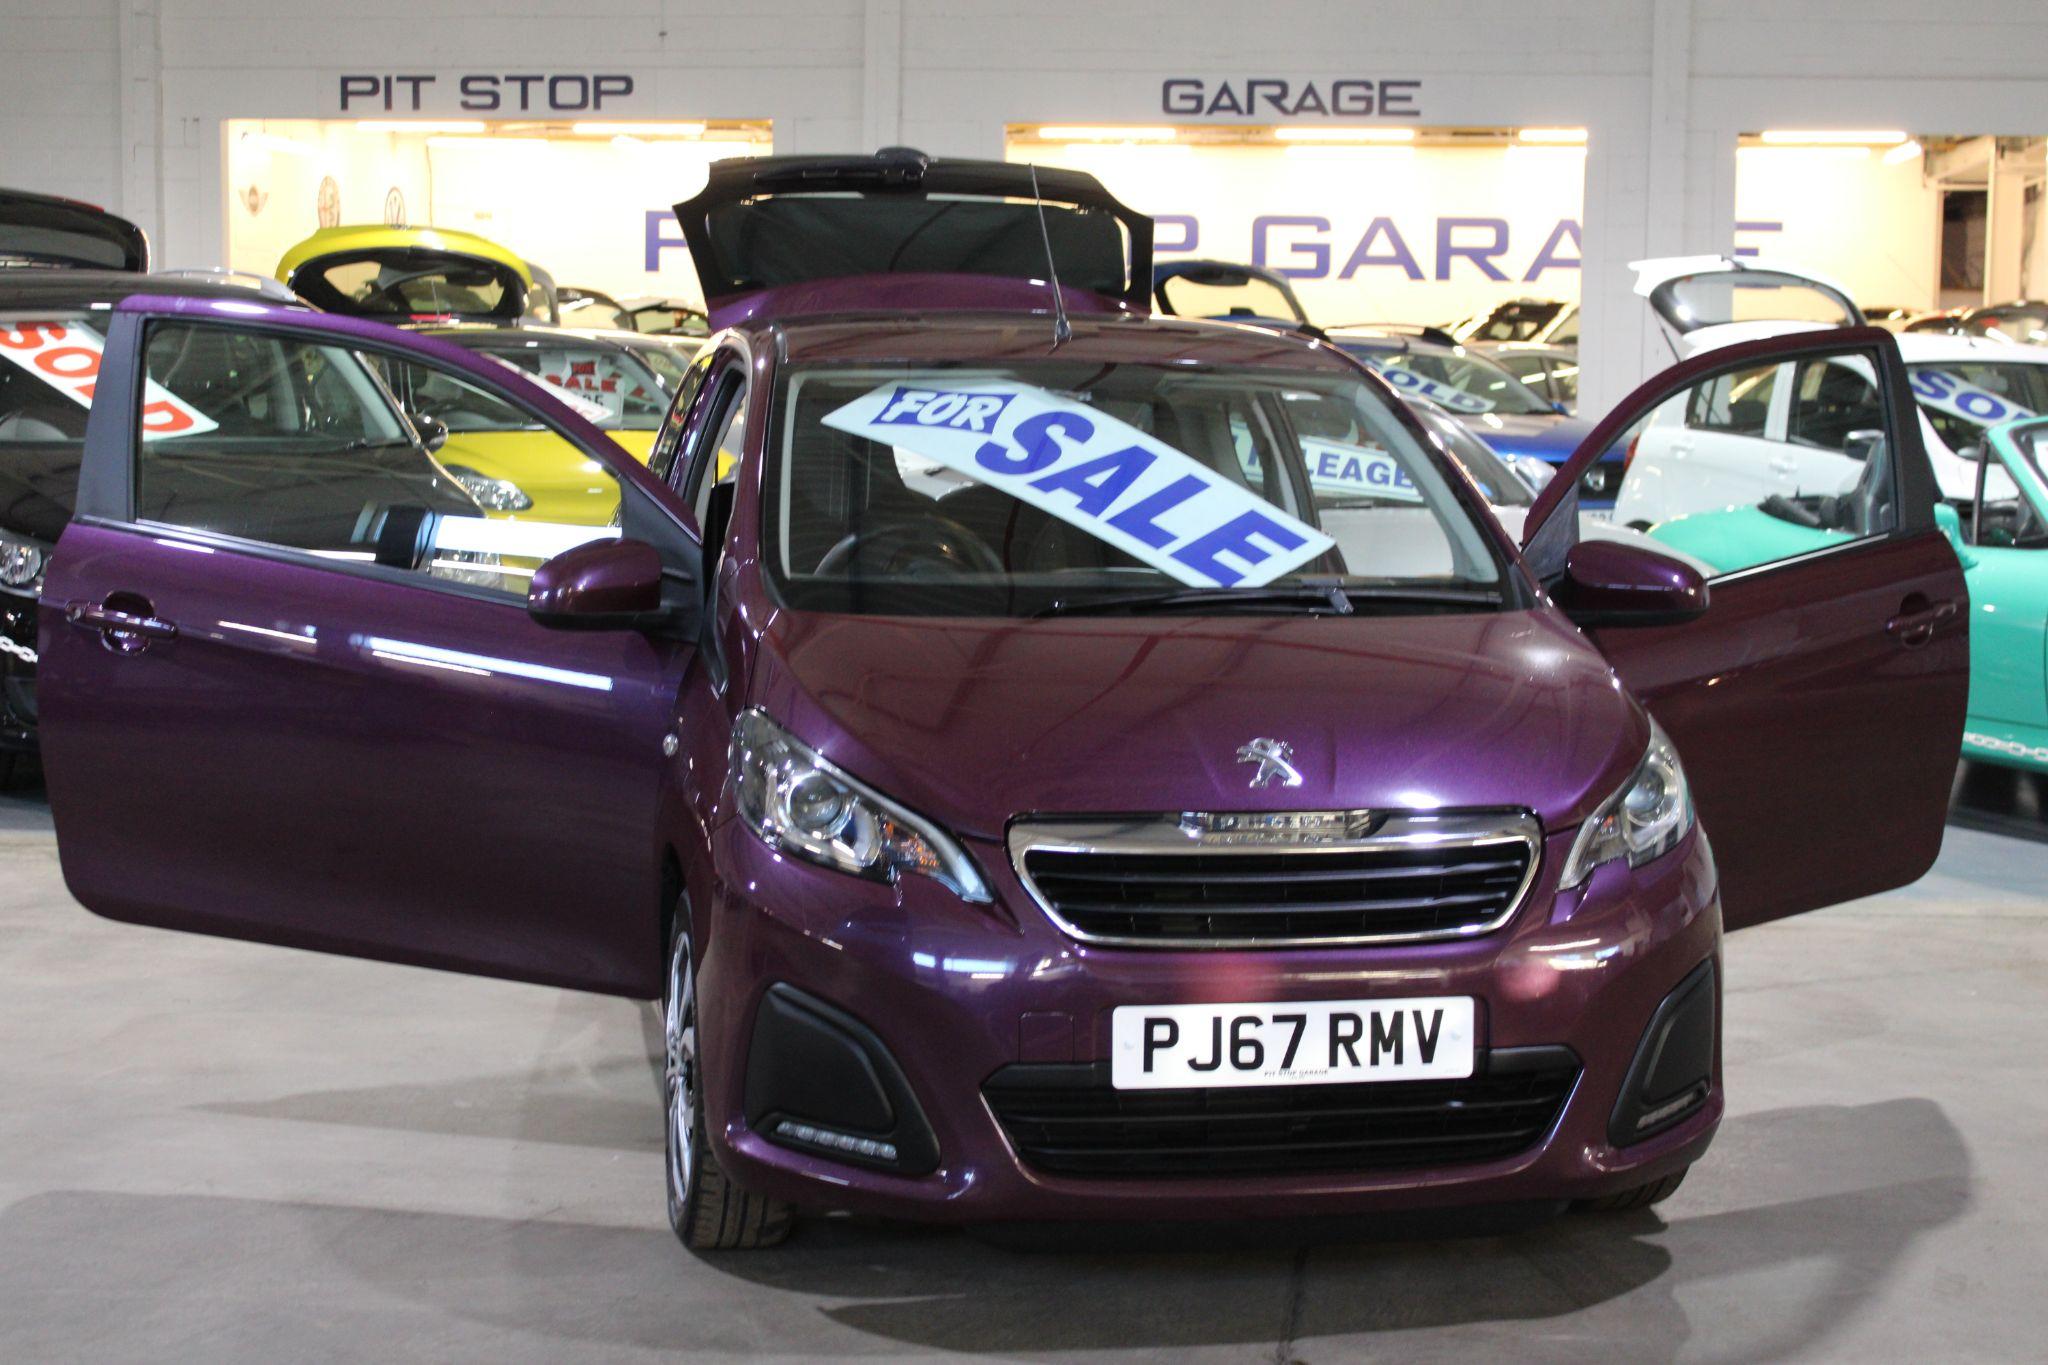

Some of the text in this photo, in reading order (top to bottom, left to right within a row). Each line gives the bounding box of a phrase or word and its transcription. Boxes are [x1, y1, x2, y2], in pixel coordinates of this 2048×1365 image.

[340, 75, 634, 111] PIT STOP
[1162, 79, 1422, 117] GARAGE
[0, 321, 195, 433] SOD
[880, 386, 1308, 589] FOR SALE
[1142, 1008, 1445, 1074] PJ67 RMV
